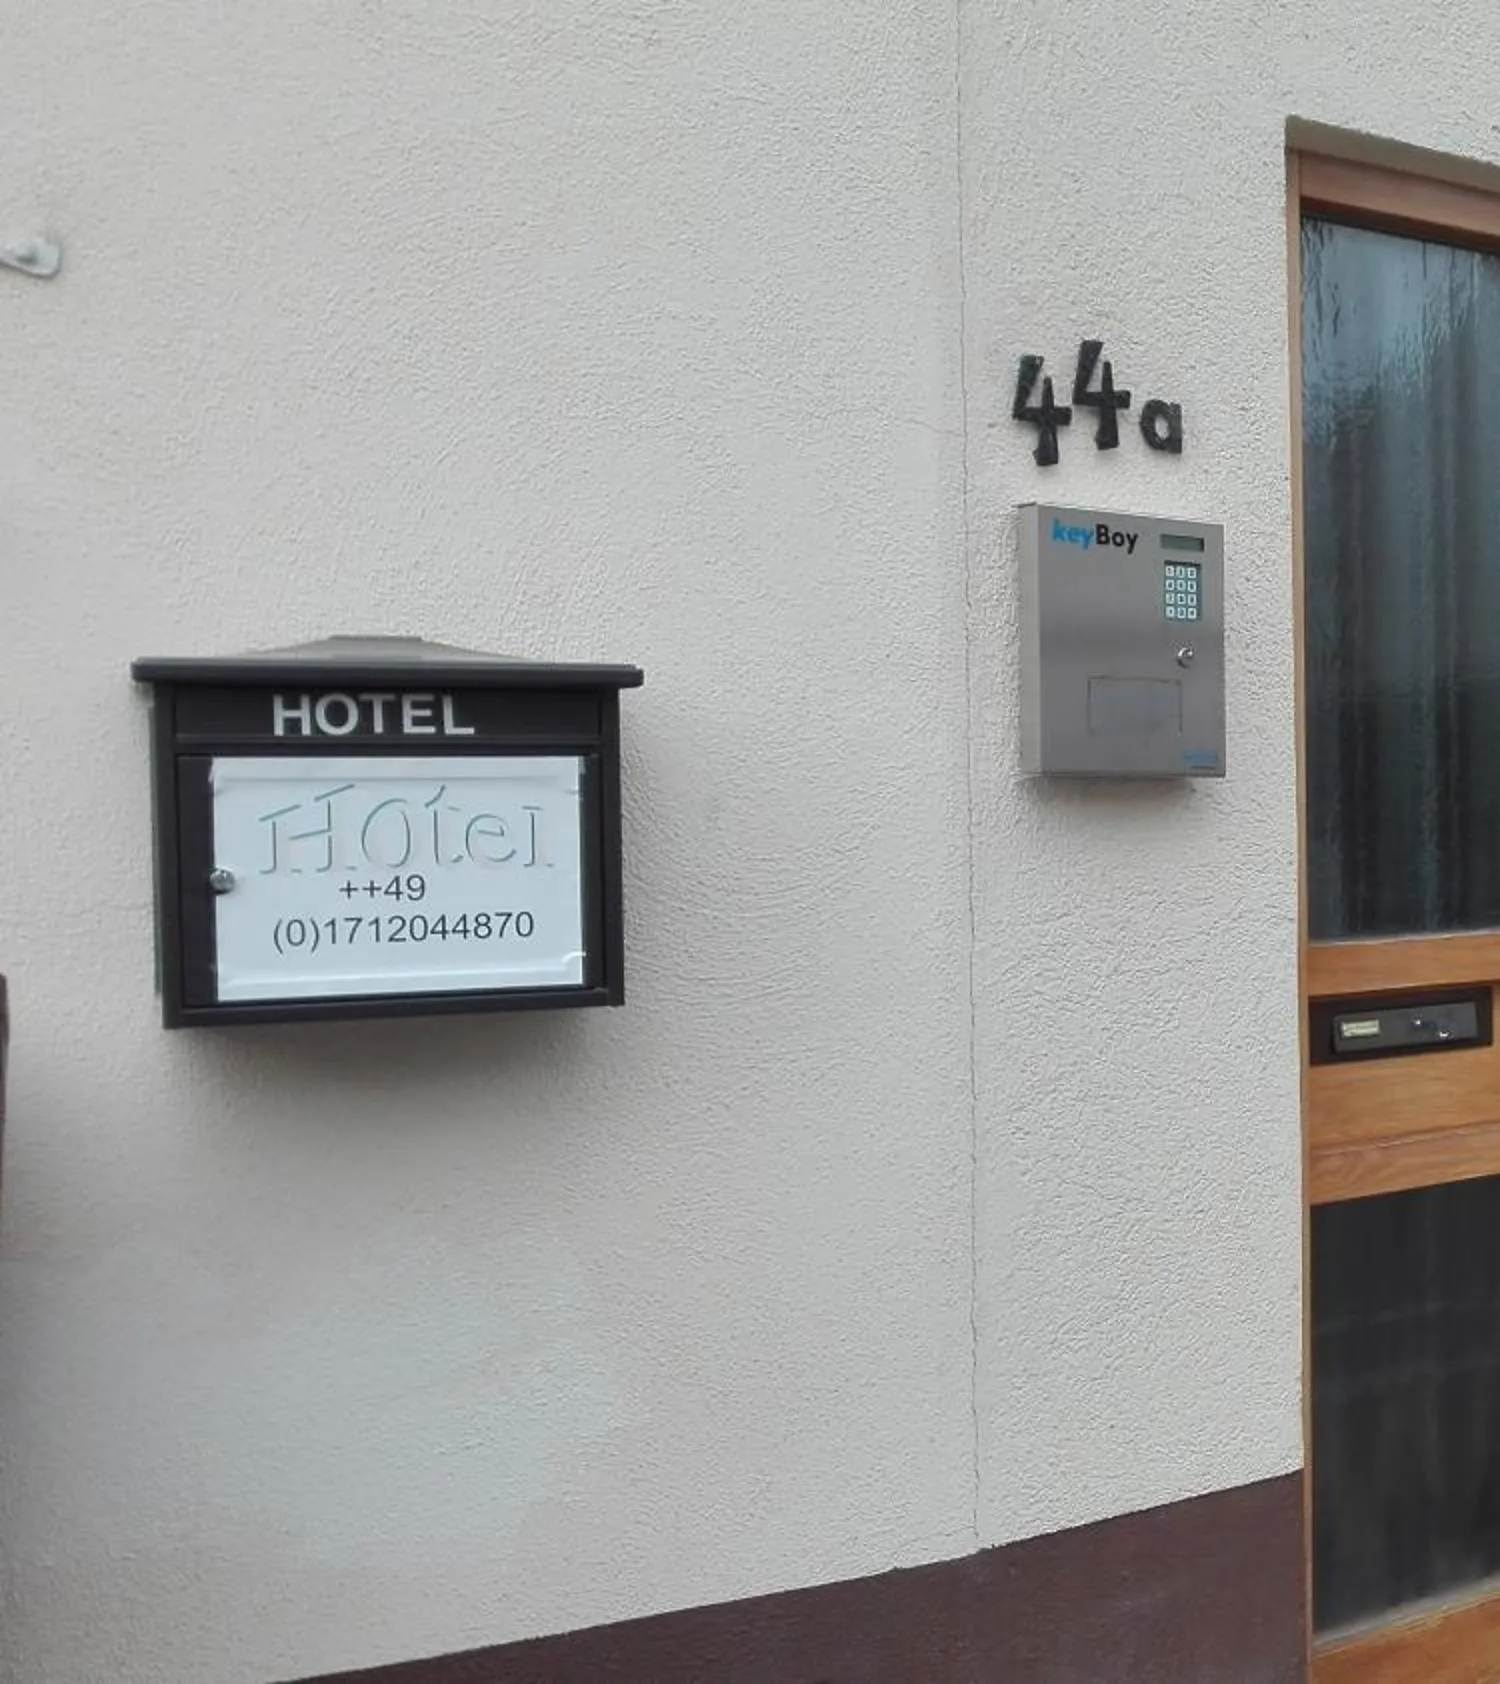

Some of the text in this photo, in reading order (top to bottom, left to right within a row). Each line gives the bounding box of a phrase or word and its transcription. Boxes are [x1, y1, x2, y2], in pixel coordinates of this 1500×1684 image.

[1012, 340, 1183, 466] 44a
[1052, 518, 1138, 554] keyBoy
[273, 694, 475, 736] HOTEL
[259, 785, 554, 875] Hotel
[340, 875, 426, 901] ++49
[273, 912, 534, 954] (0)1712044870
